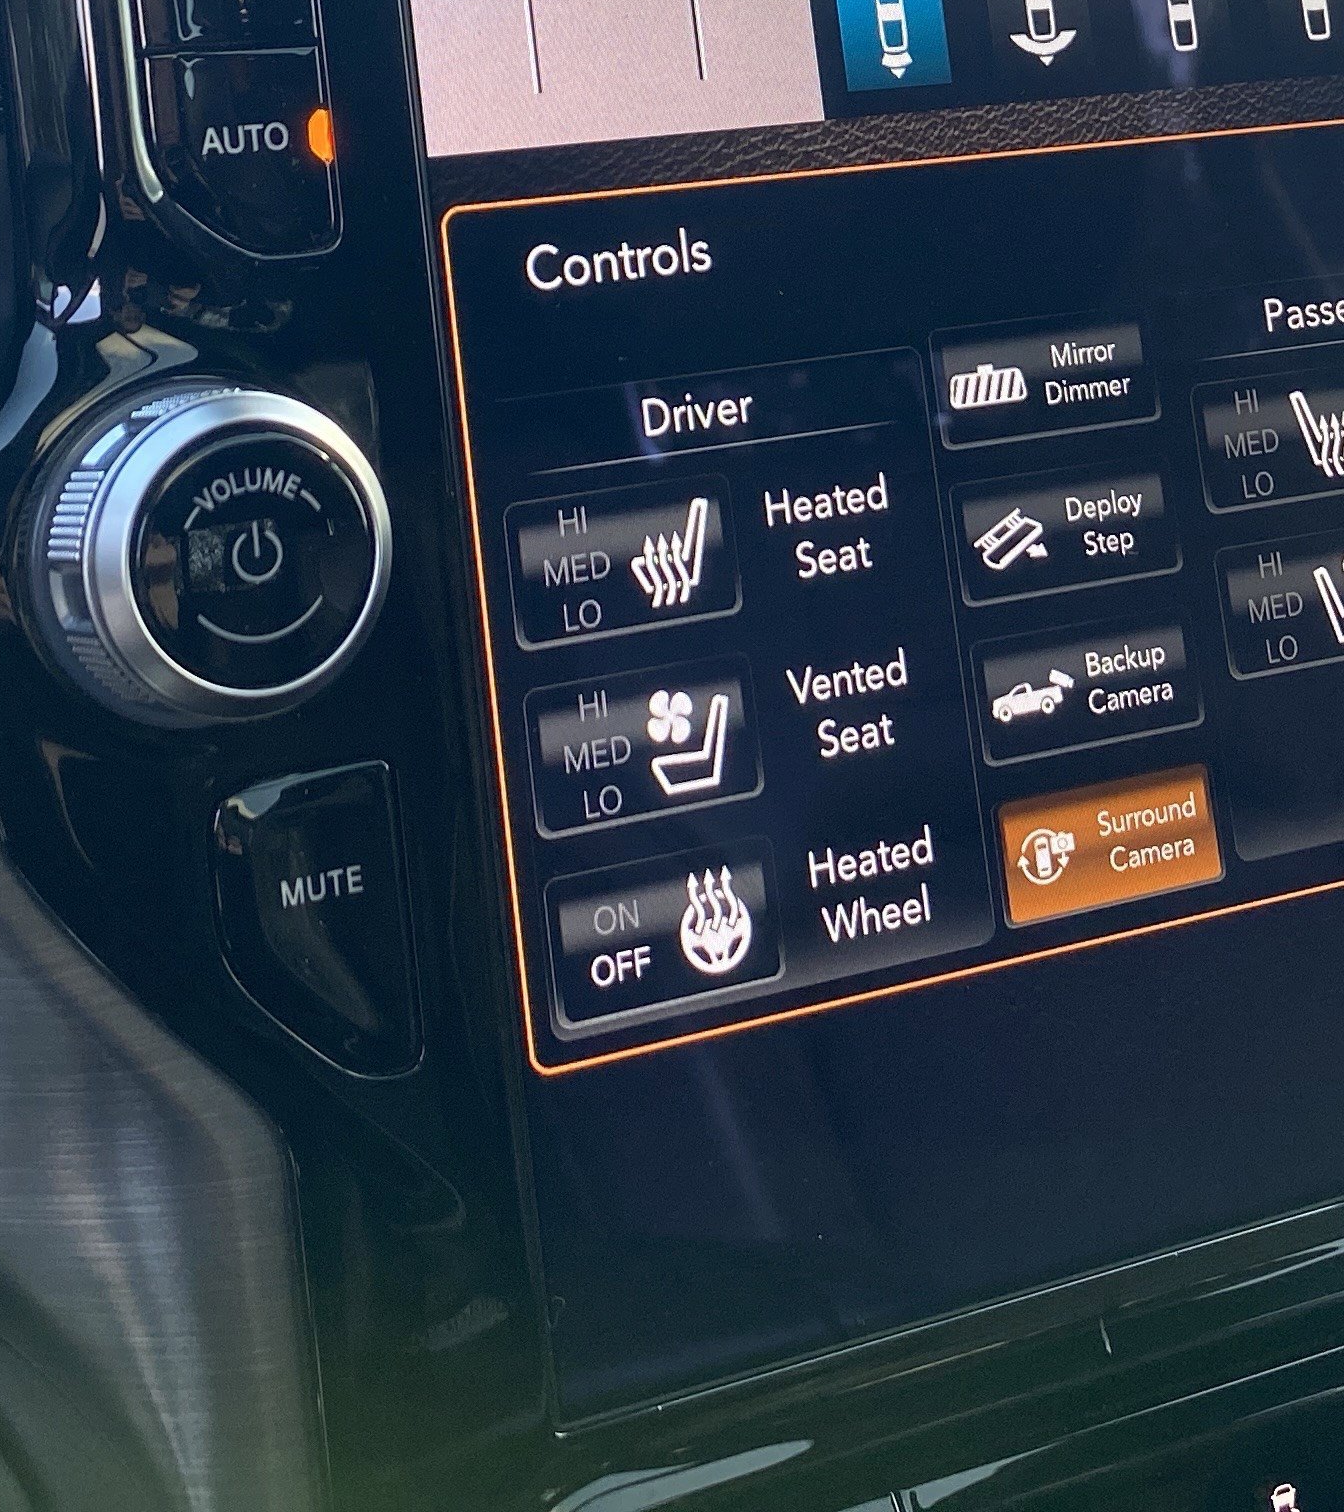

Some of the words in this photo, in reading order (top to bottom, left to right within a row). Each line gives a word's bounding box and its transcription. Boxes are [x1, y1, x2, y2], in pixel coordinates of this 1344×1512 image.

[201, 121, 289, 156] AUTO
[525, 227, 713, 291] Controls
[1049, 340, 1116, 369] Mirror
[1044, 374, 1131, 406] Dimmer
[1234, 388, 1260, 416] HI
[641, 392, 753, 438] Driver
[1223, 427, 1279, 460] MED
[195, 466, 302, 512] VOLUME
[764, 472, 889, 528] Heated
[1241, 470, 1275, 499] LO
[557, 505, 588, 537] HI
[1064, 488, 1143, 525] Deploy
[795, 536, 874, 579] Seat
[1083, 526, 1134, 559] Step
[543, 550, 611, 588] MED
[1257, 550, 1284, 580] HI
[562, 598, 602, 633] LO
[1246, 591, 1304, 625] MED
[1084, 643, 1166, 679] Backup
[1264, 635, 1299, 664] LO
[786, 646, 908, 705] Vented
[577, 688, 609, 724] HI
[1087, 680, 1174, 716] Camera
[563, 734, 632, 774] MED
[817, 713, 896, 759] Seat
[583, 784, 623, 821] LO
[1096, 791, 1198, 837] Surround
[807, 823, 934, 889] Heated
[1108, 835, 1196, 874] Camera
[280, 864, 364, 910] MUTE
[592, 899, 641, 936] ON
[821, 882, 932, 944] Wheel
[590, 944, 652, 988] OFF
